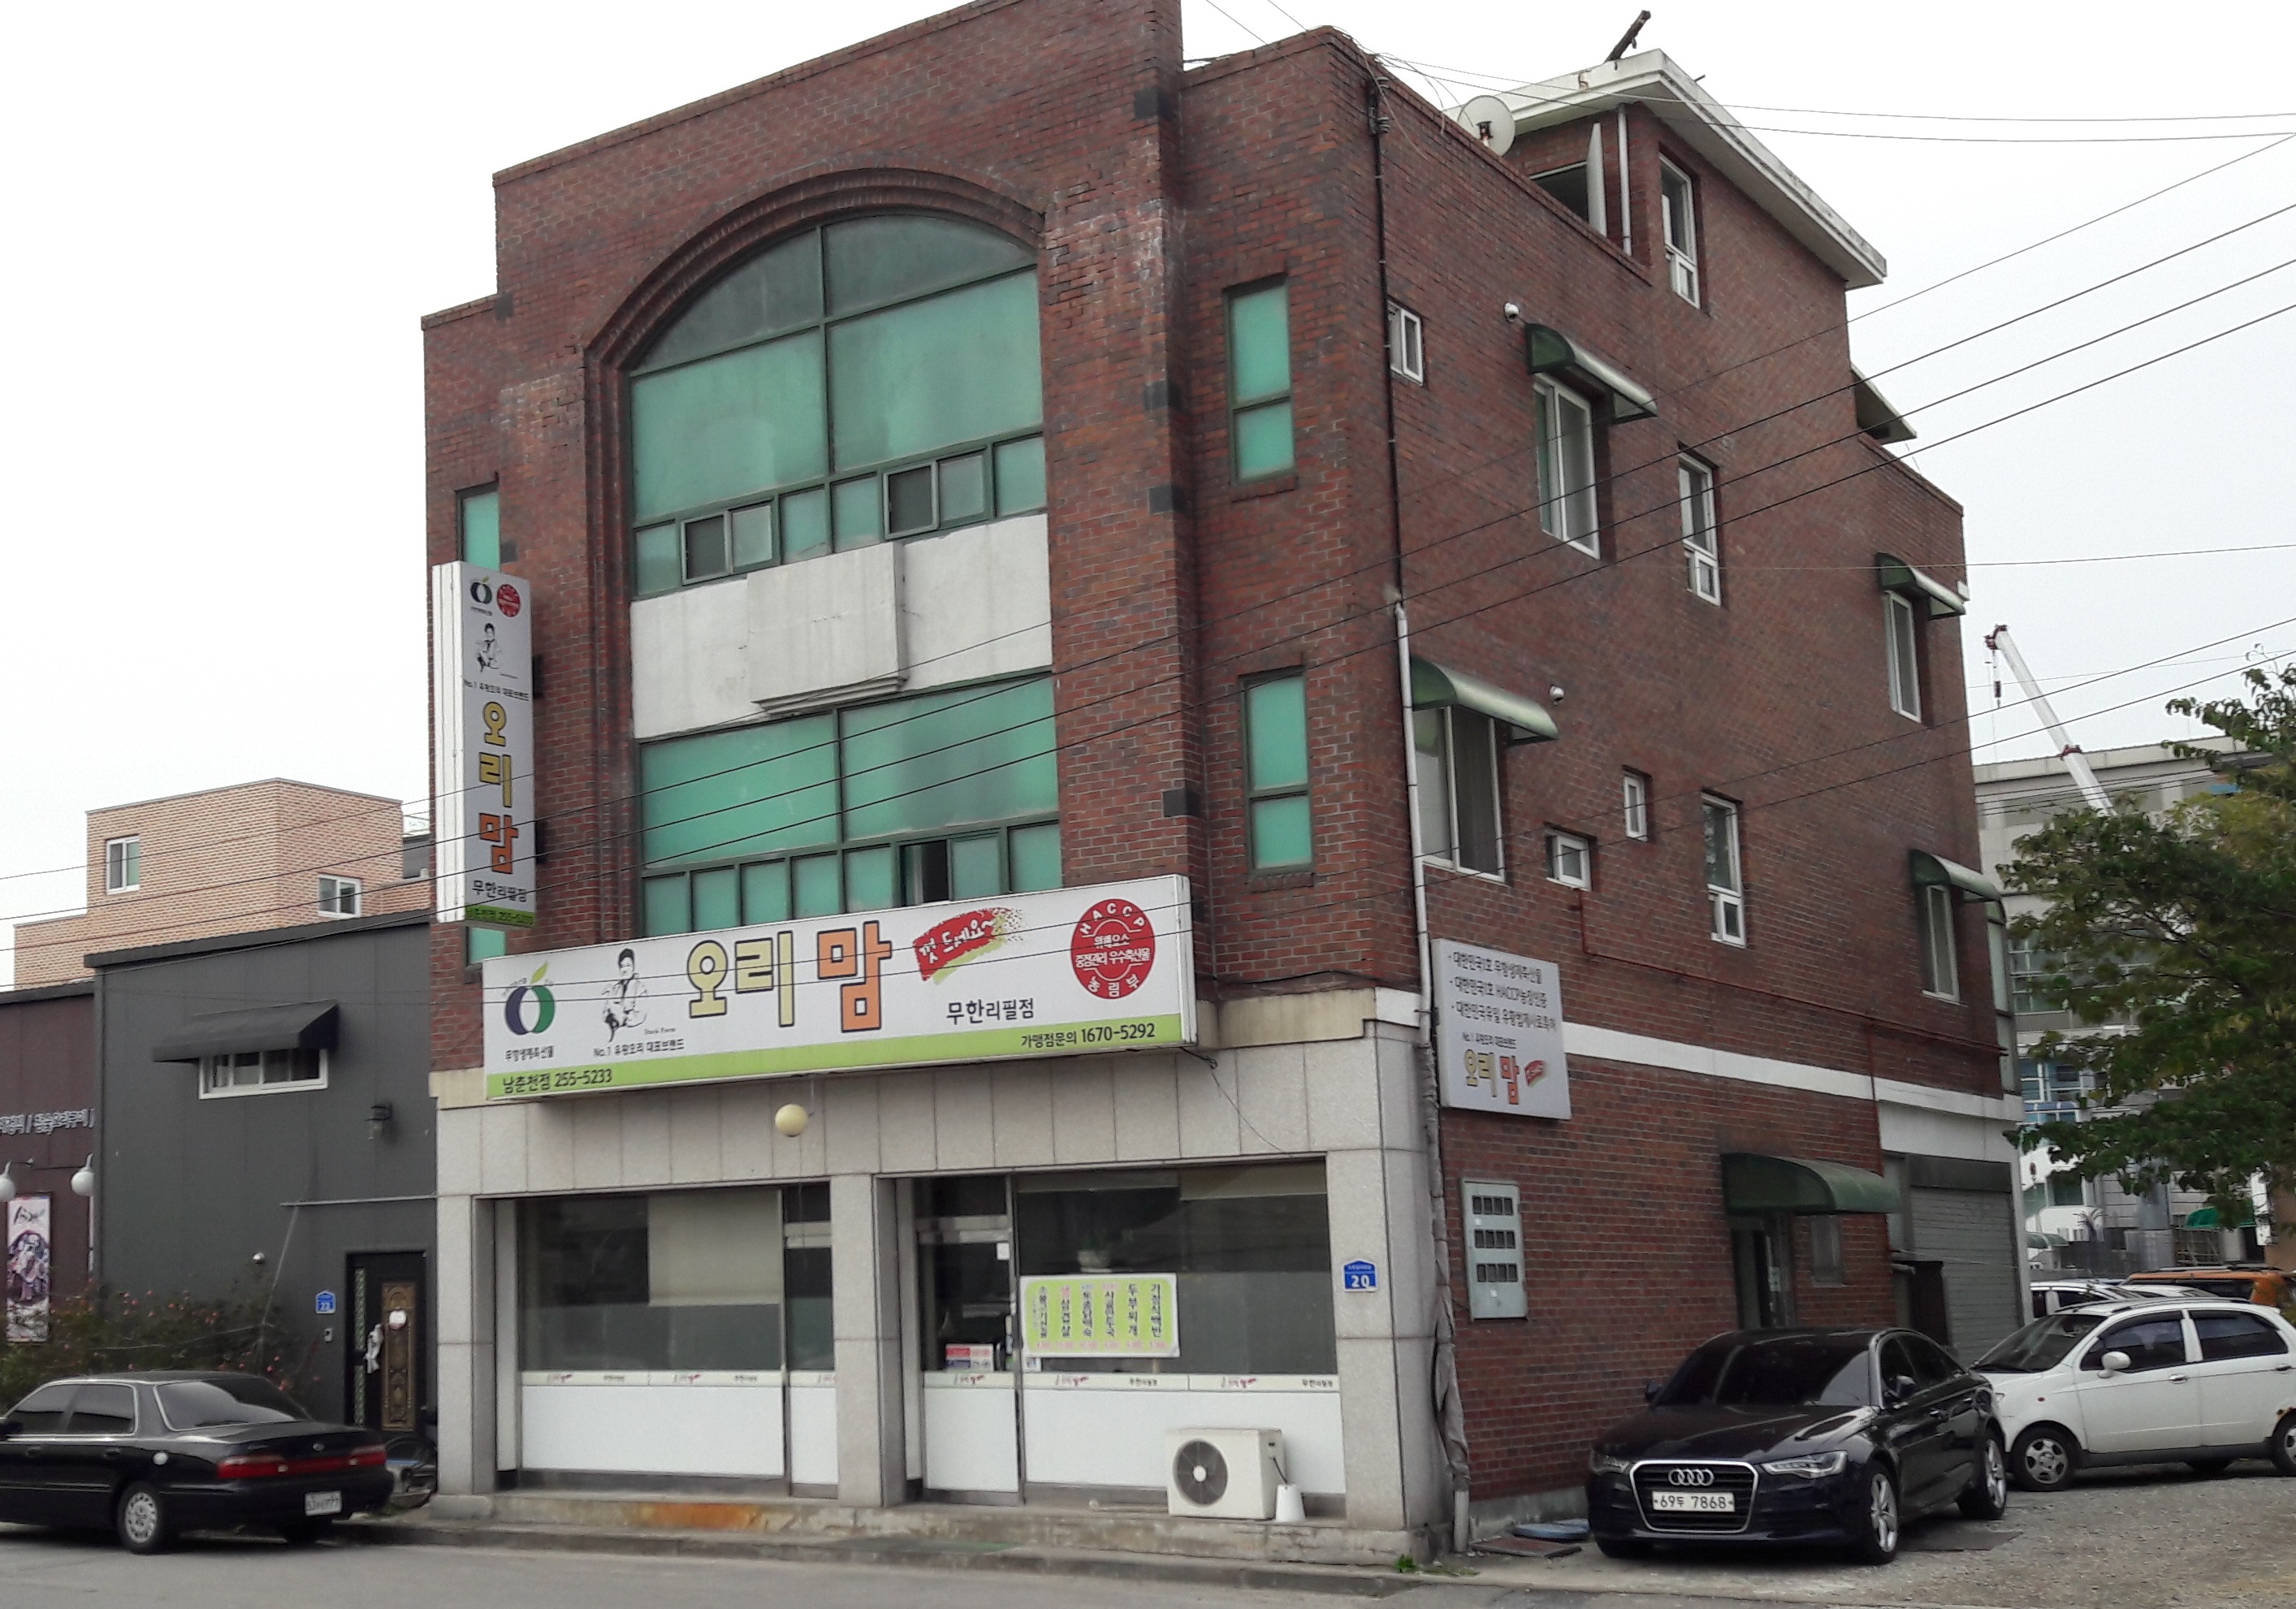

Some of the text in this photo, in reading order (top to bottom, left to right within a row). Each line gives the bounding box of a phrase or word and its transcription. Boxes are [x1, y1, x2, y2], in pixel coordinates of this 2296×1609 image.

[479, 701, 519, 875] 오리맘
[1079, 902, 1145, 934] HACCP
[687, 919, 893, 1032] 오리맘
[946, 998, 1035, 1024] 무한리필점
[1021, 1023, 1155, 1049] 가맹점문의 1670-5292
[503, 1069, 612, 1093] 남춘천점 255-5233
[1351, 1274, 1370, 1288] 20
[1691, 1496, 1727, 1509] 7868
